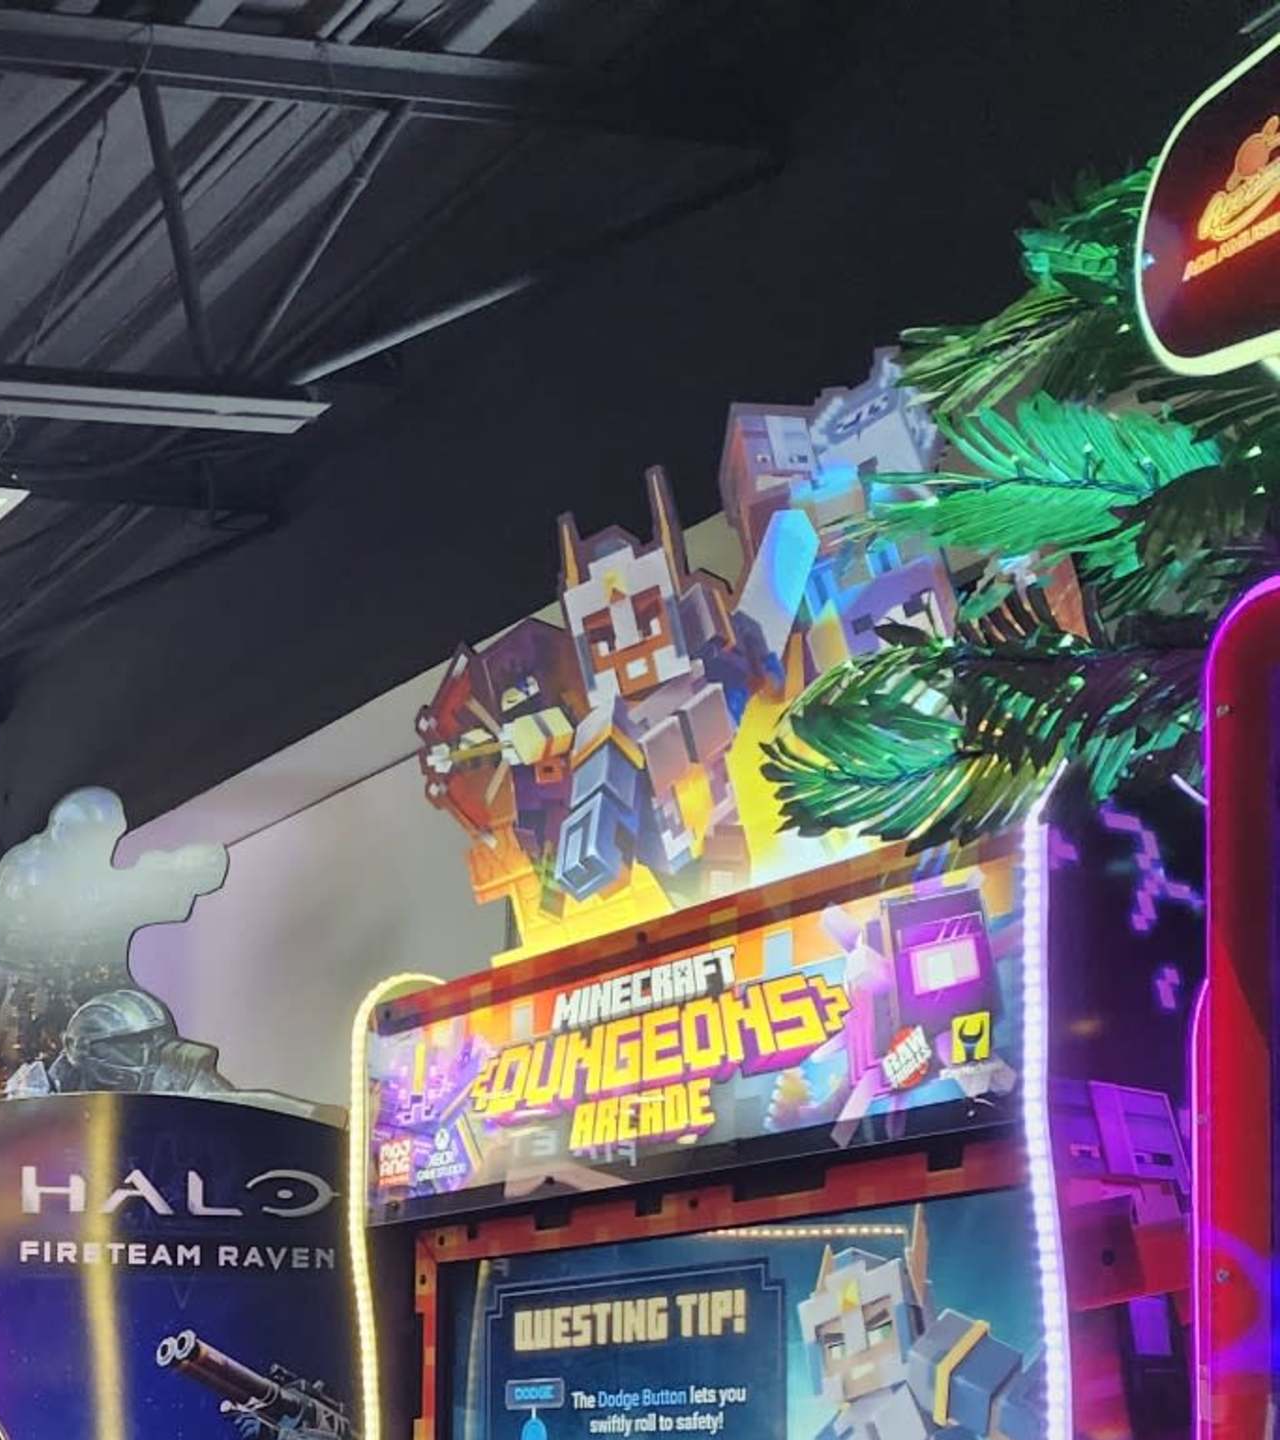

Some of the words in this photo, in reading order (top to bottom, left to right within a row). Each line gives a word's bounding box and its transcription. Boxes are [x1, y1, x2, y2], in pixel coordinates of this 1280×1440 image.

[551, 947, 736, 1032] MINECRAFT
[489, 975, 828, 1113] DUNGEONS
[568, 1077, 715, 1151] ARCADE
[21, 1166, 340, 1218] HALO
[19, 1241, 201, 1266] FIRETEAM
[218, 1246, 334, 1270] RAVEN
[513, 1297, 669, 1351] QUESTING
[676, 1289, 746, 1337] TIP!
[571, 1390, 596, 1409] The
[598, 1388, 639, 1411] Dodge
[642, 1387, 687, 1406] Button
[690, 1385, 716, 1404] lets
[718, 1386, 746, 1407] you
[590, 1414, 632, 1437] swiftly
[634, 1414, 656, 1432] roll
[659, 1413, 673, 1431] to
[675, 1411, 725, 1434] safety!
